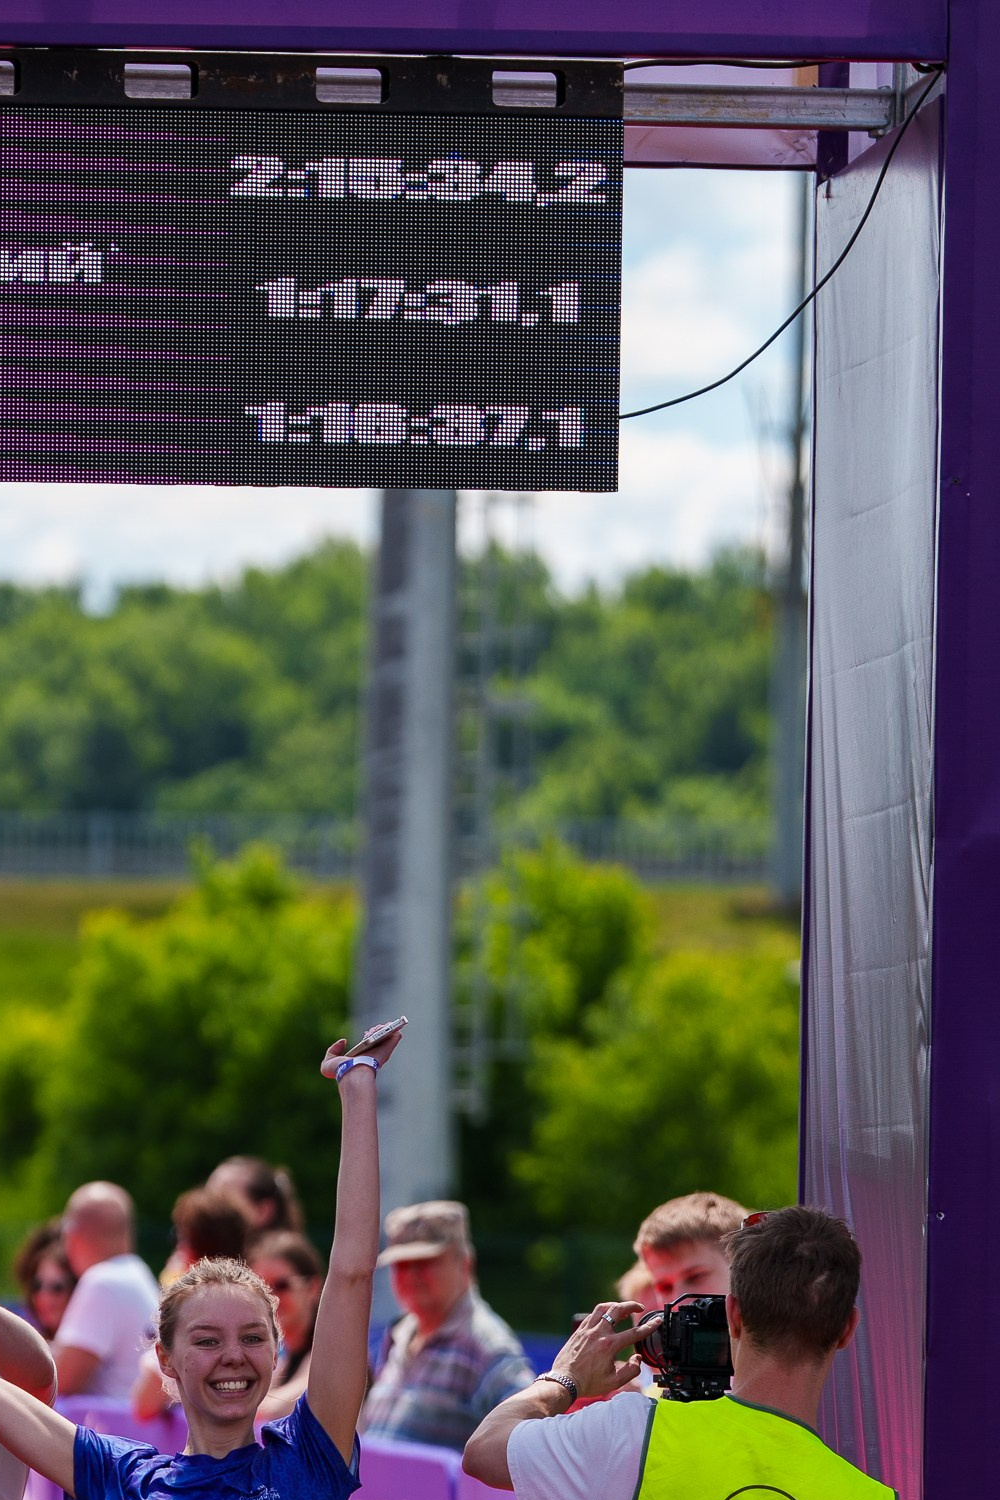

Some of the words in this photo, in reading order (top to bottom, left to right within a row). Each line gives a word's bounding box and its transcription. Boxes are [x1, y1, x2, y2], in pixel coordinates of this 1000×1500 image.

[230, 155, 607, 206] 2:15:34,2
[255, 277, 580, 326] 1:17:31,1
[244, 402, 585, 450] 1:16:37,1
